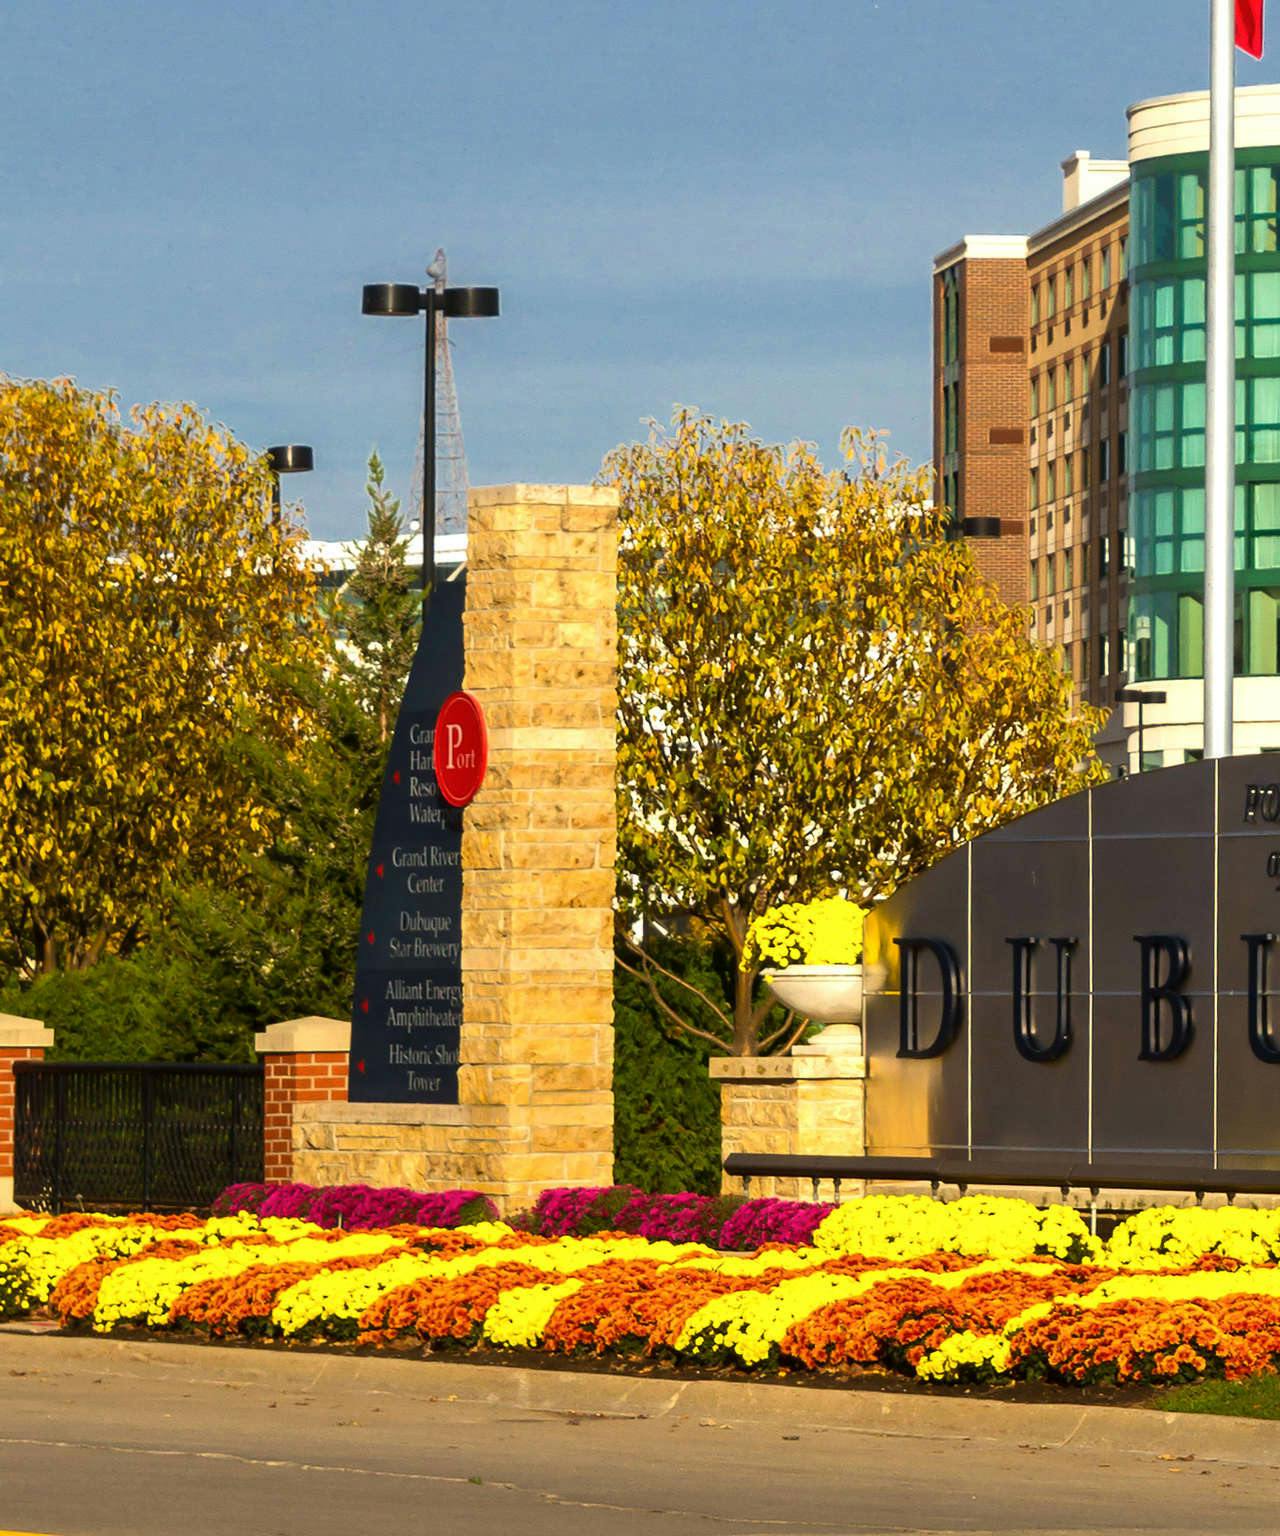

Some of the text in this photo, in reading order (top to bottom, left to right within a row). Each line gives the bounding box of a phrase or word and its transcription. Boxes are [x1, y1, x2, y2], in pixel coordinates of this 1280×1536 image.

[446, 724, 476, 770] Port
[392, 846, 460, 867] Grand River
[407, 873, 444, 894] Center
[400, 911, 452, 939] Dubuque
[389, 937, 460, 965] Star Brewery
[385, 980, 423, 1000] Alliant
[386, 1006, 462, 1034] Amphitheater
[389, 1044, 432, 1065] Historic
[407, 1070, 441, 1092] Tower
